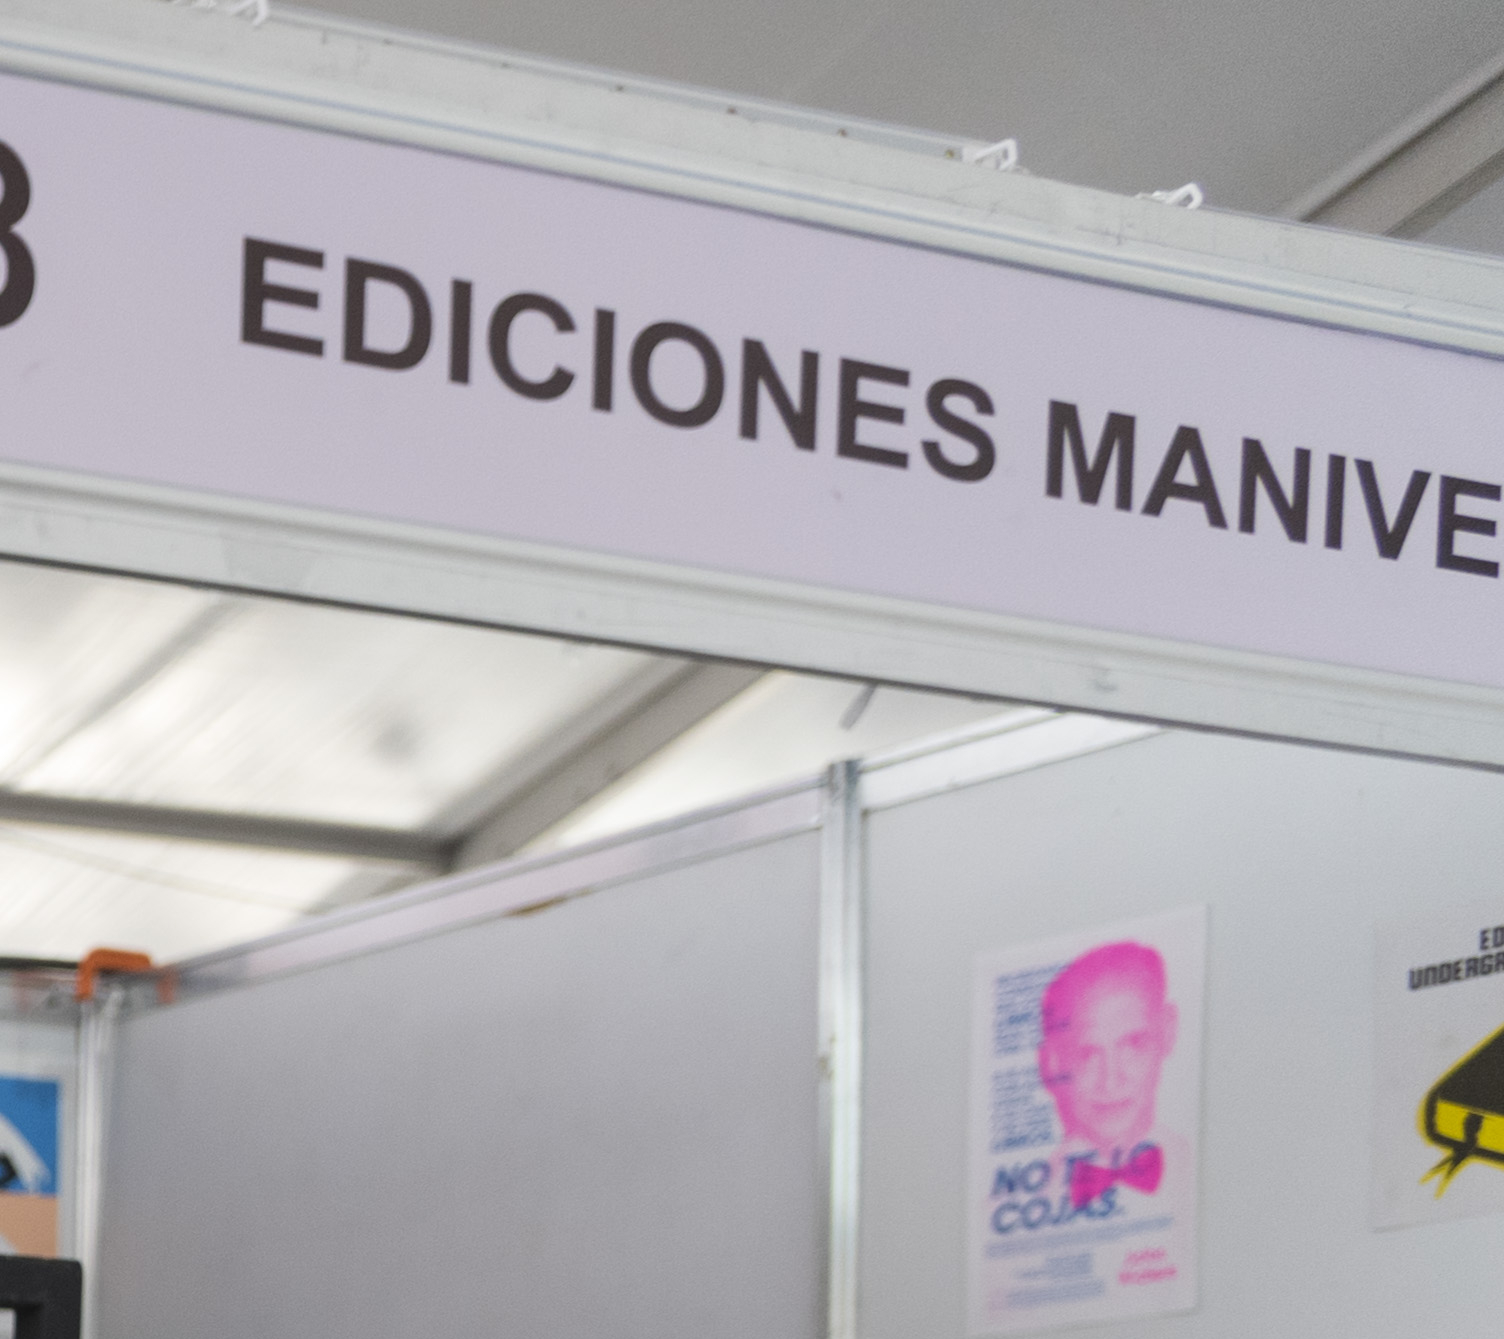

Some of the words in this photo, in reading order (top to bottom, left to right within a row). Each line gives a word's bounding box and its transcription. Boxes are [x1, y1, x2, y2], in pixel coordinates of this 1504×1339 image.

[237, 234, 998, 486] EDICIONES
[1044, 398, 1504, 580] MANIVE
[991, 1161, 1050, 1199] NO
